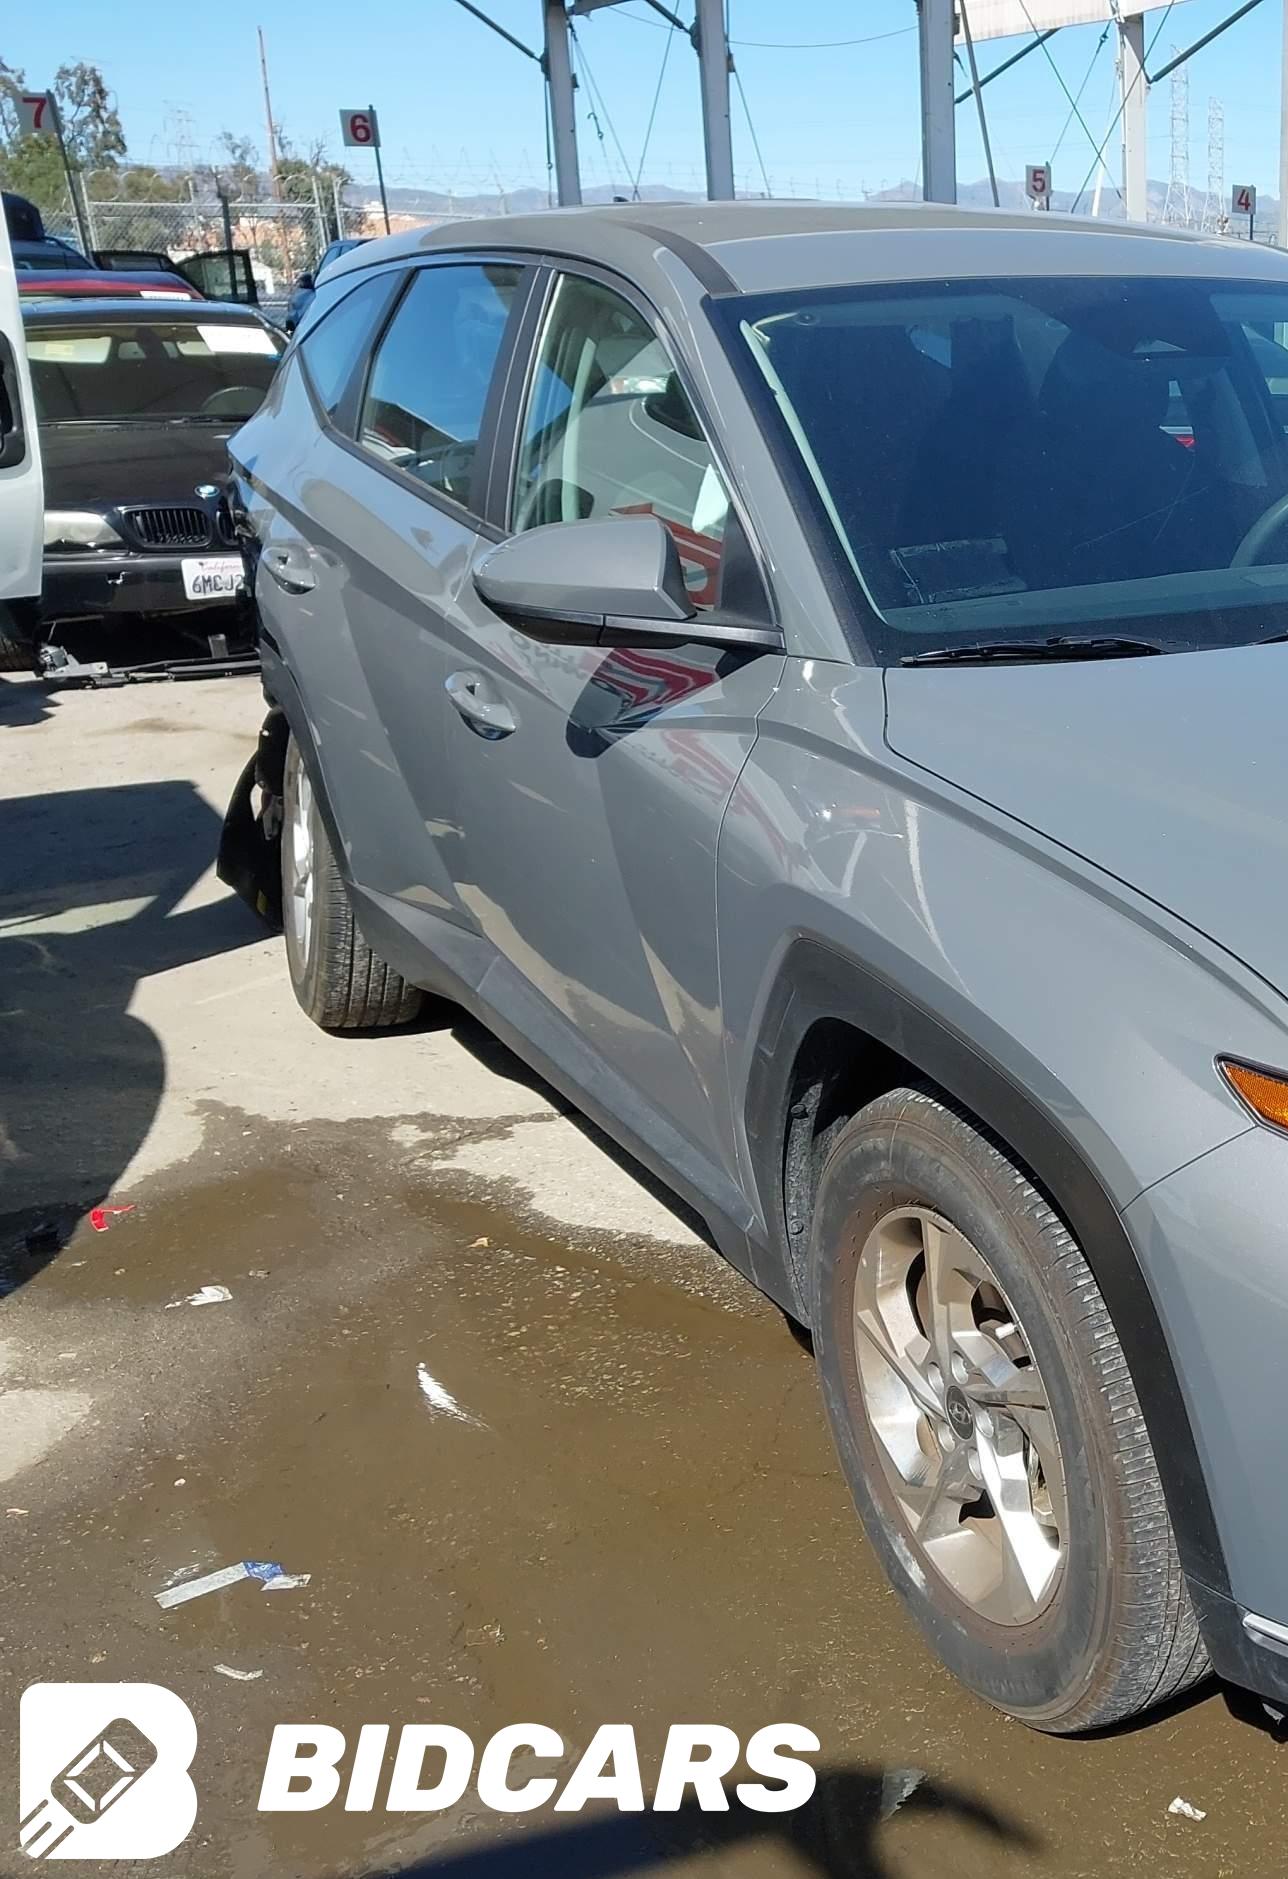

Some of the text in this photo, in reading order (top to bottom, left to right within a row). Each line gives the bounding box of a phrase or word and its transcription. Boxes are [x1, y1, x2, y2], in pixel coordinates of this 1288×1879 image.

[22, 97, 47, 128] 7
[351, 114, 371, 142] 6
[1032, 169, 1045, 192] 5
[1237, 188, 1251, 211] 4
